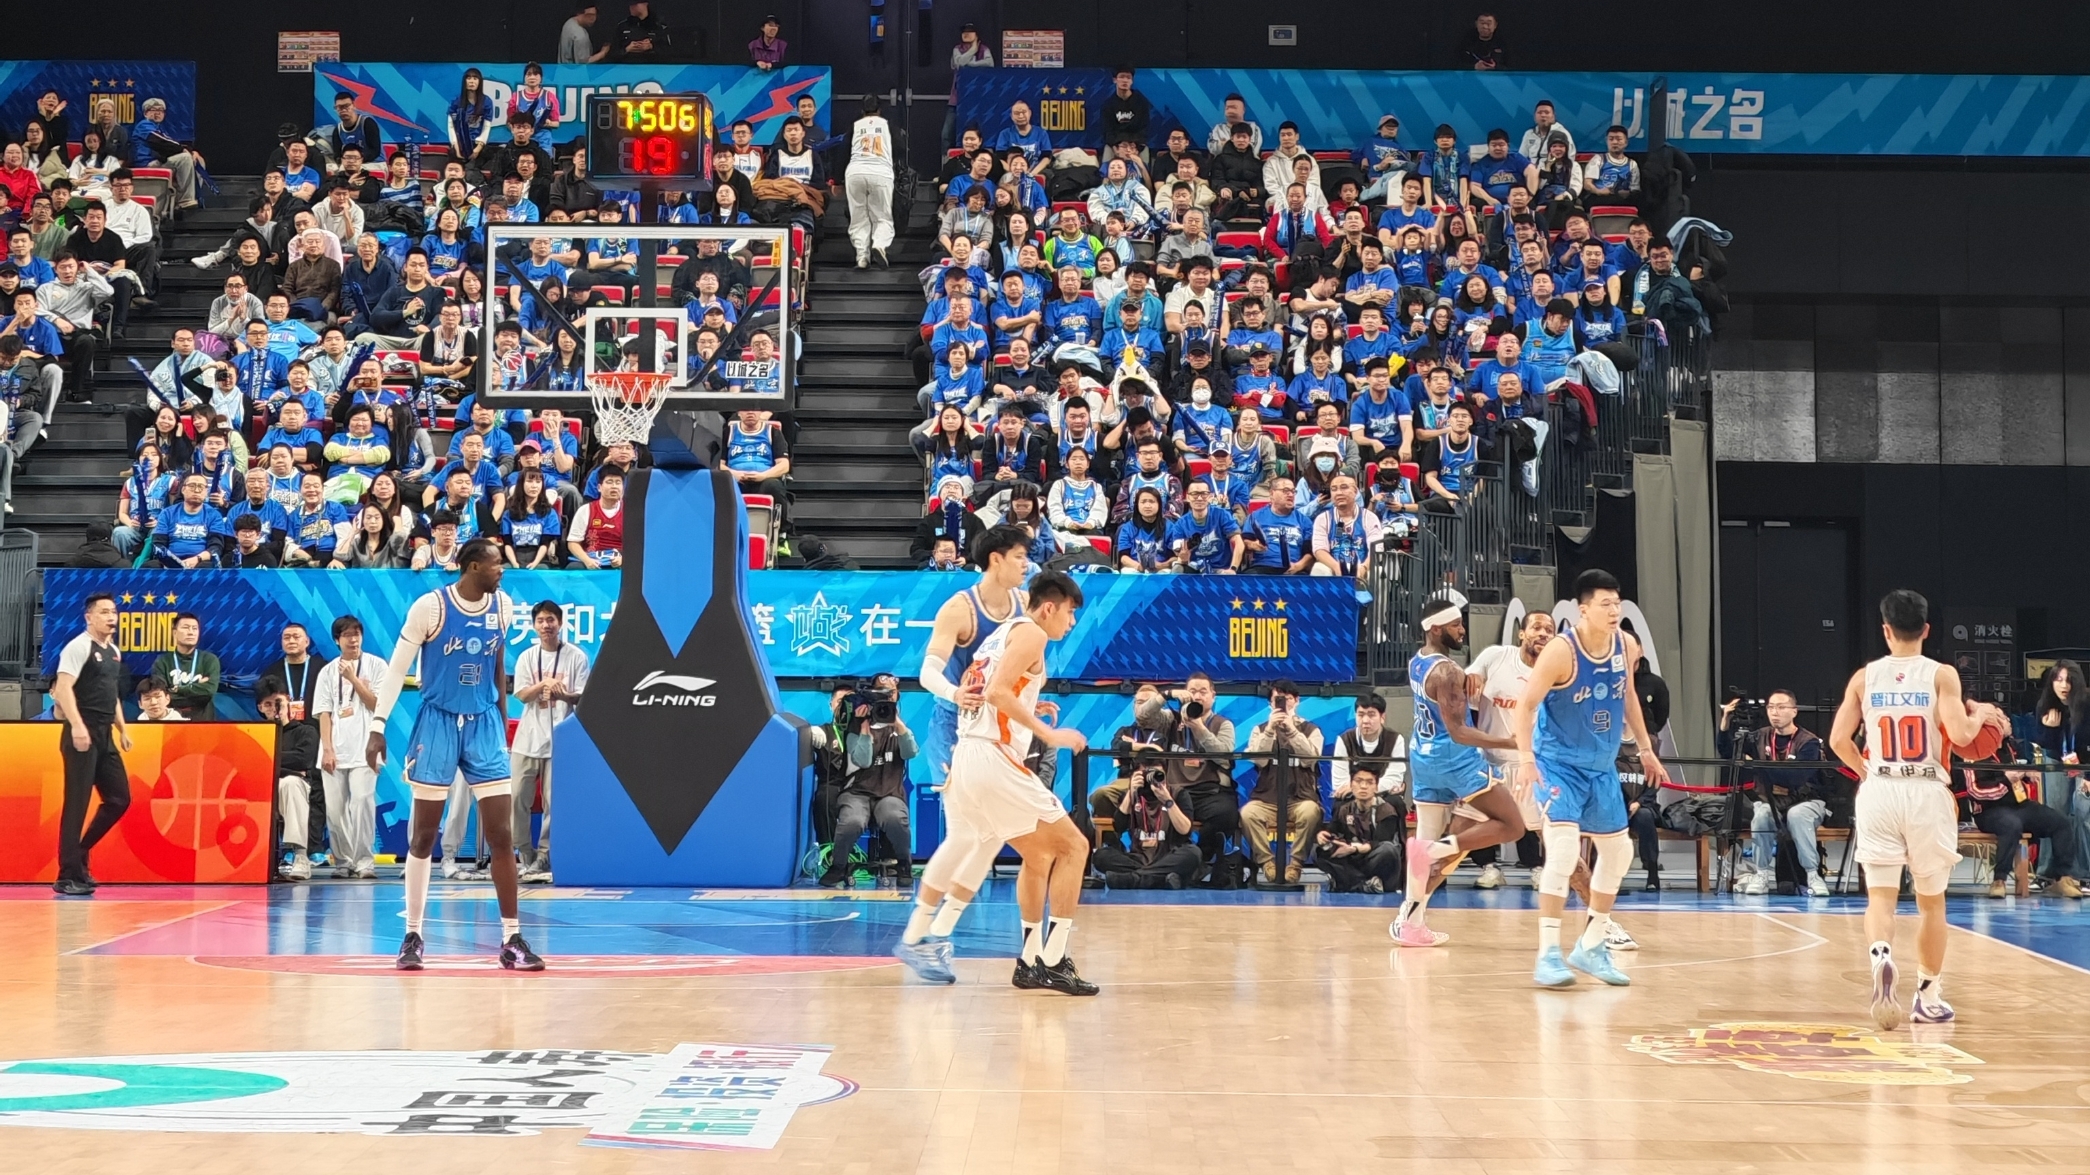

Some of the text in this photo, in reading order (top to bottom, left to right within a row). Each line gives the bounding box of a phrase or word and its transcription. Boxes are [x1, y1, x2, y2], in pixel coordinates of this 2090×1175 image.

[1040, 100, 1086, 131] BEIJING
[633, 137, 674, 175] 19
[726, 362, 769, 378] 以城之名
[1229, 617, 1288, 658] BEIJING
[1974, 624, 2014, 638] 消火栓
[443, 634, 500, 657] 北京
[633, 694, 718, 707] LI-NING
[1572, 675, 1627, 704] 北京
[1871, 692, 1930, 708] 晋江文旅
[1593, 710, 1611, 734] 9
[1877, 715, 1928, 763] 10
